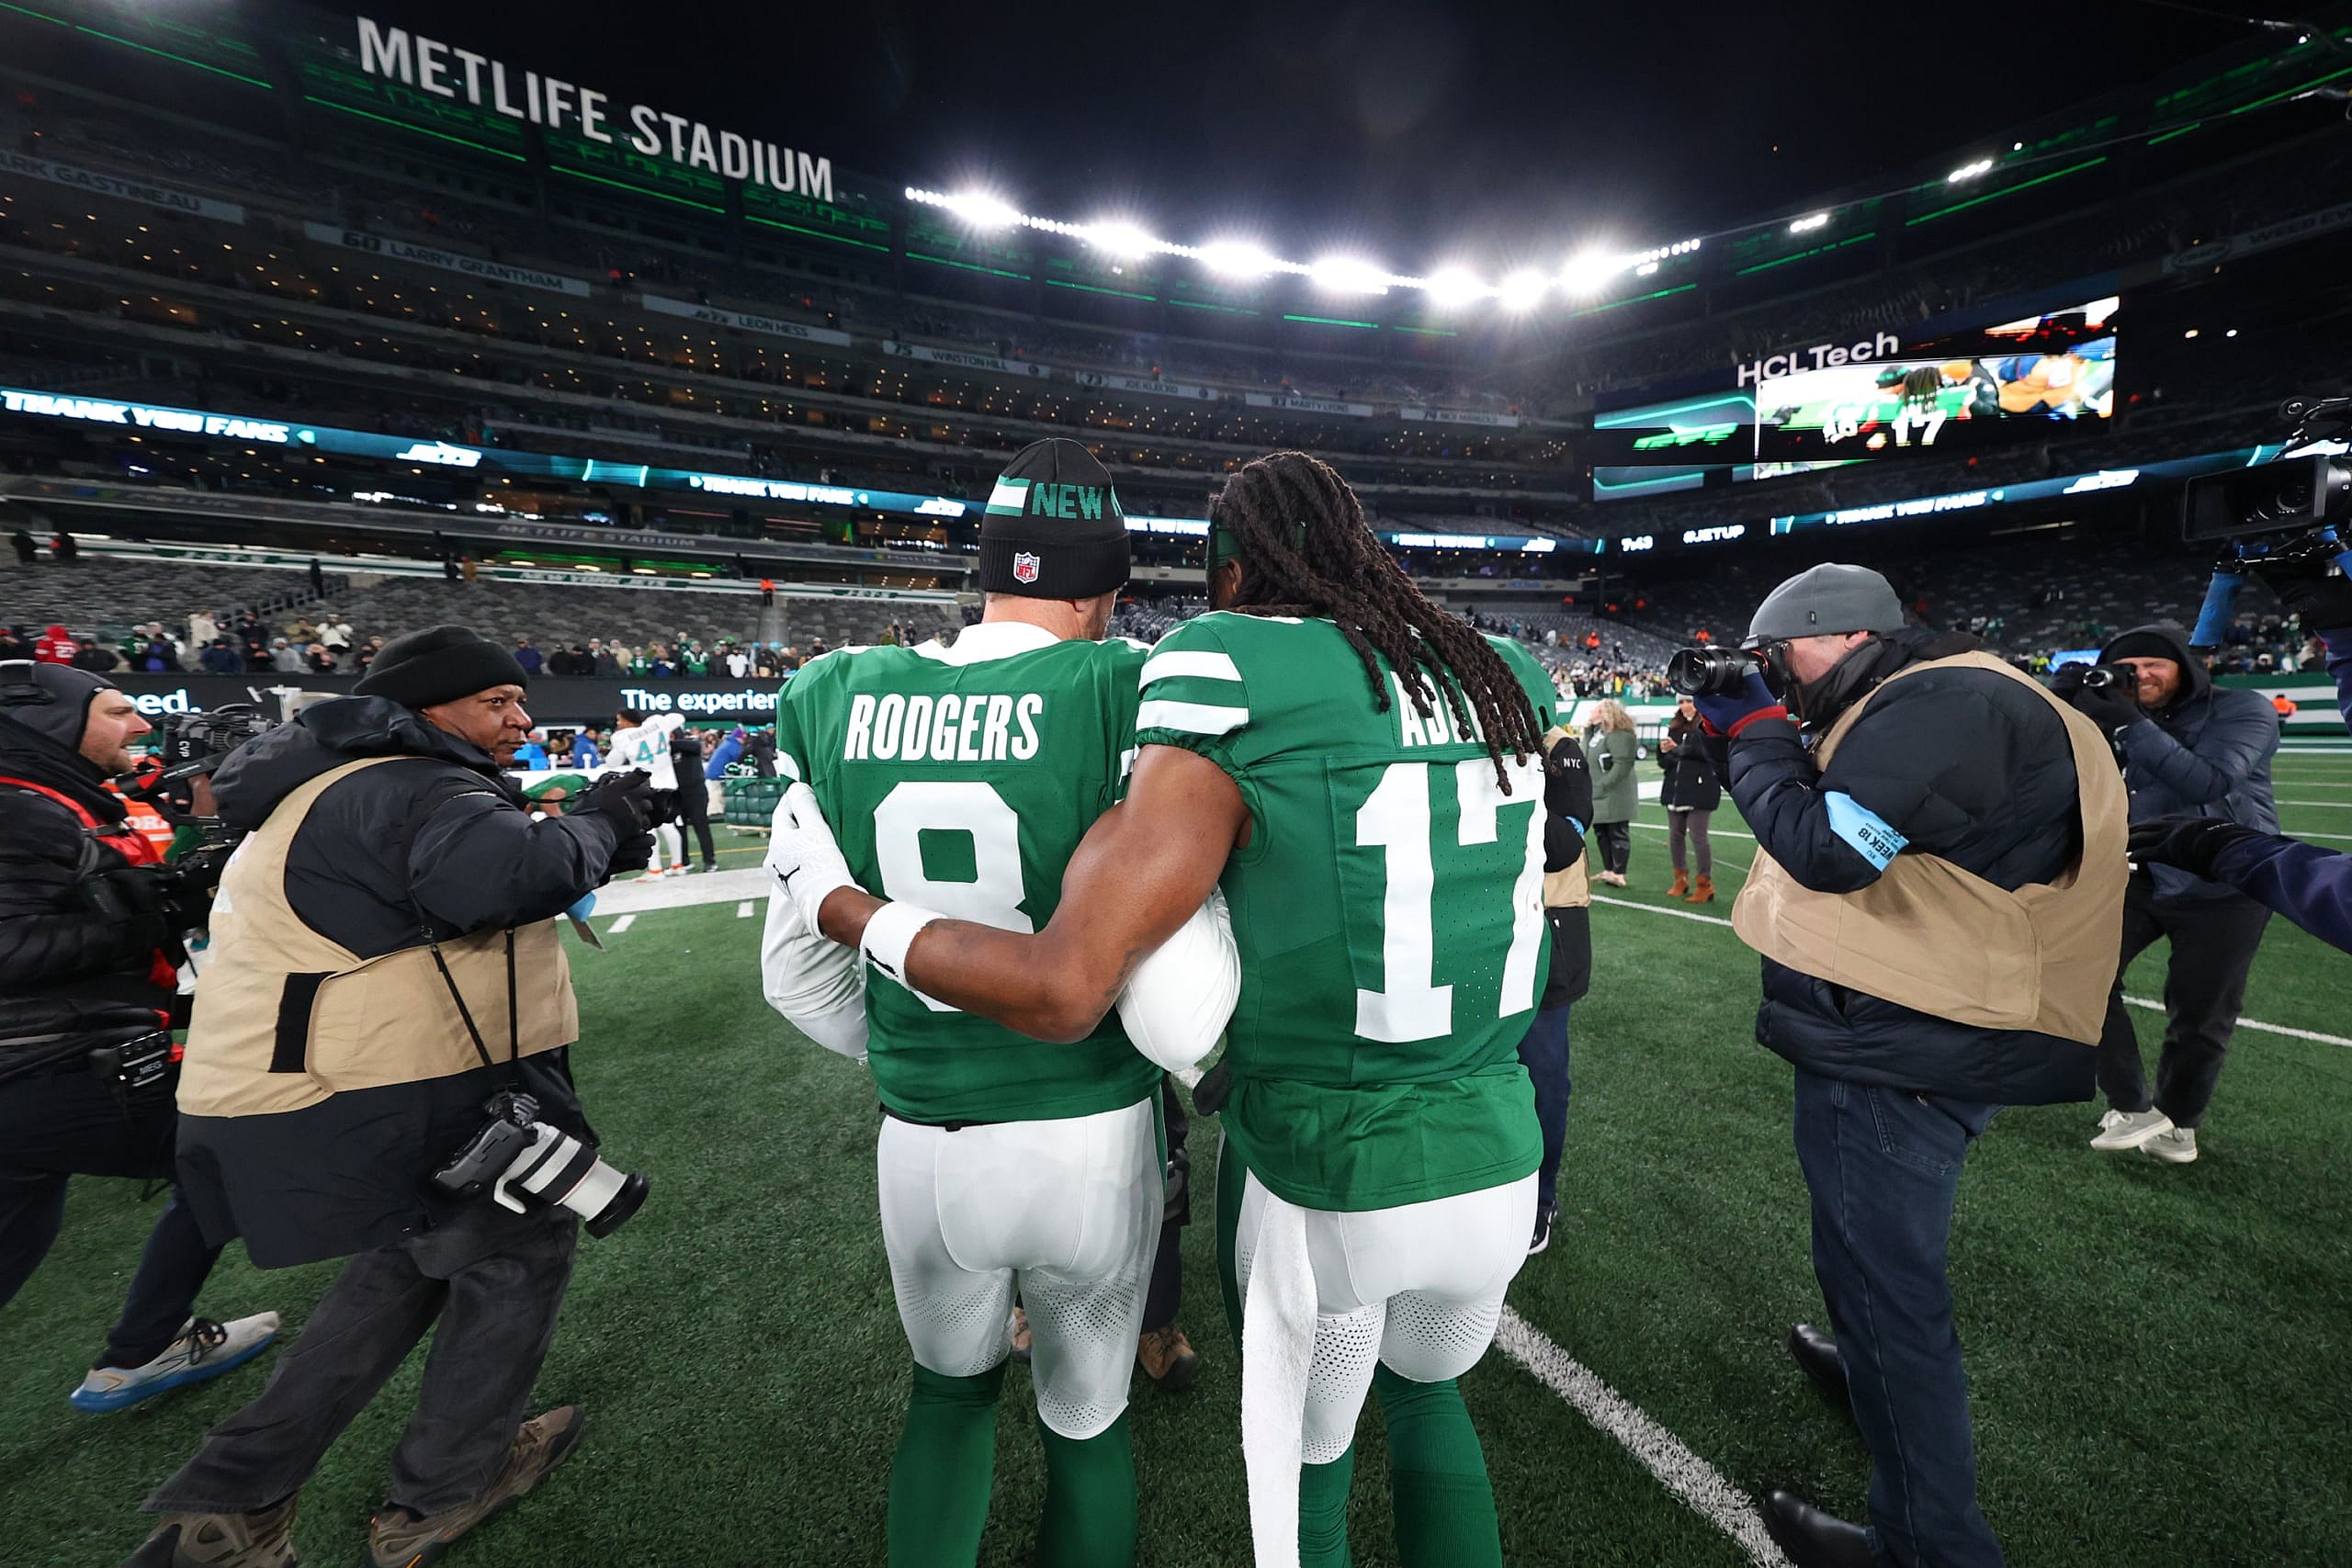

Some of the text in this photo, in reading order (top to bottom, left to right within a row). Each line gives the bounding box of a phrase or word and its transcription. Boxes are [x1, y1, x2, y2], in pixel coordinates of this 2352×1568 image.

[356, 16, 834, 203] METLIFE STADIUM
[390, 242, 455, 266] LARRY
[460, 259, 563, 290] GRANTHAM
[1, 390, 289, 442] THANK YOU FANS
[1031, 482, 1105, 520] NEW
[497, 525, 696, 547] METLIFE STADIUM
[620, 689, 673, 711] The
[843, 694, 1045, 762] RODGERS
[1563, 757, 1582, 770] NYC
[1858, 828, 1871, 841] 18
[1869, 837, 1894, 861] WEEK
[873, 781, 1035, 1012] 8
[1354, 753, 1549, 1043] 17
